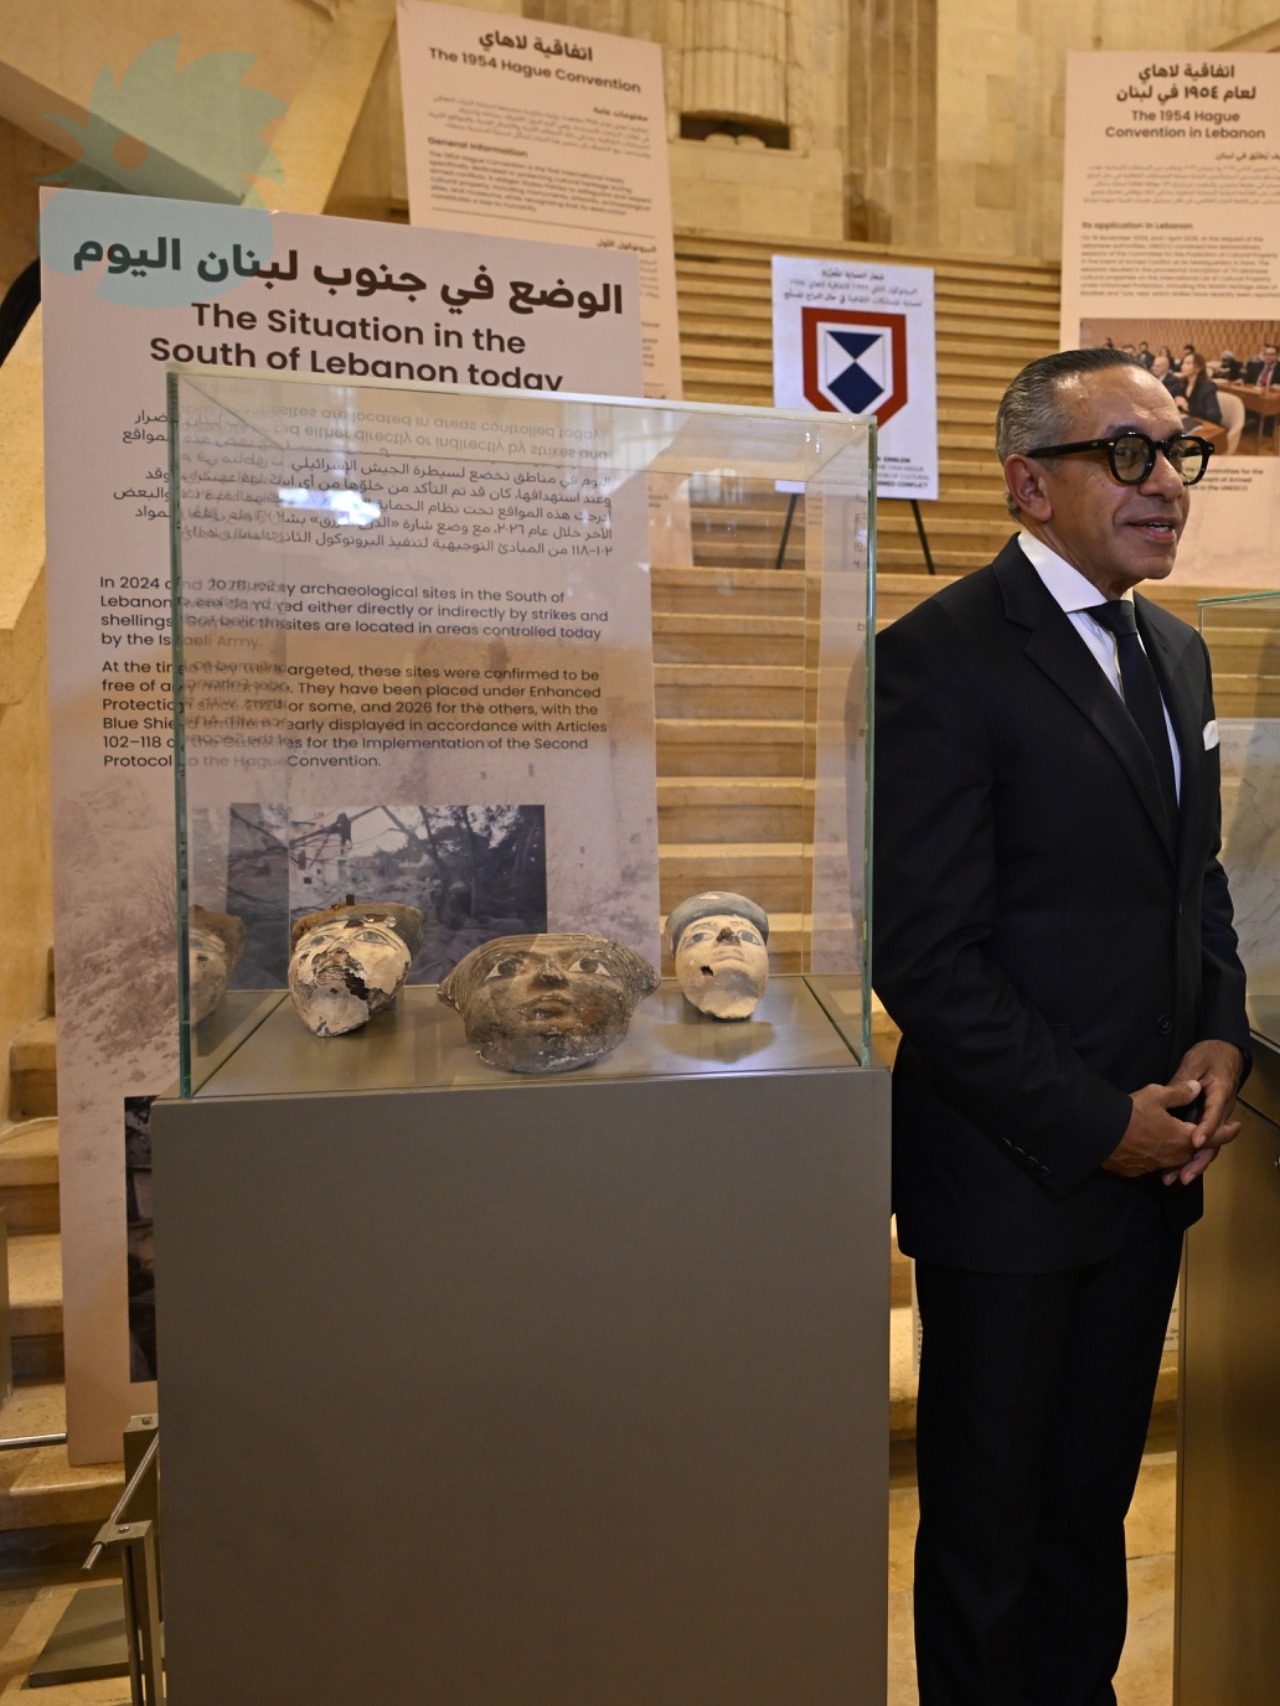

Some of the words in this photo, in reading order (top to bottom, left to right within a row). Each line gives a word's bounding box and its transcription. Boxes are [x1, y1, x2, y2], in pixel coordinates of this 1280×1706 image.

[479, 30, 527, 52] لاهاي
[533, 36, 593, 62] اتفاقية
[429, 46, 458, 63] The
[462, 51, 497, 69] 1954
[501, 59, 551, 79] Hague
[555, 68, 641, 93] Convention
[1138, 64, 1179, 84] لاهاي
[1184, 63, 1235, 80] اتفاقية
[1116, 85, 1152, 102] لبنان
[1157, 84, 1179, 104] في
[1184, 85, 1218, 100] ١٩٥٤
[1223, 86, 1256, 103] لعام
[1132, 110, 1156, 122] The
[1160, 109, 1191, 121] 1954
[1194, 111, 1240, 125] Hague
[1105, 126, 1186, 138] Convention
[1189, 126, 1202, 138] in
[1205, 127, 1265, 139] Lebanon
[74, 236, 180, 278] اليوم
[198, 243, 297, 290] لبنان
[314, 264, 426, 302] جنوب
[440, 264, 494, 315] في
[509, 278, 622, 317] الوضع
[191, 302, 257, 330] The
[268, 308, 423, 345] Situation
[434, 322, 463, 349] in
[473, 328, 525, 355] the
[151, 337, 255, 368] South
[267, 346, 300, 372] of
[311, 349, 458, 384] Lebanon
[468, 363, 562, 391] today
[100, 576, 114, 588] In
[120, 575, 160, 590] 2024
[300, 582, 418, 601] archaeological
[423, 586, 456, 600] sites
[461, 588, 473, 600] in
[478, 589, 501, 601] the
[506, 590, 547, 603] South
[551, 591, 564, 603] of
[101, 595, 171, 608] Lebanon
[307, 600, 353, 615] either
[357, 602, 414, 620] directly
[418, 606, 433, 616] or
[438, 604, 505, 622] indirectly
[510, 608, 527, 623] by
[532, 608, 576, 621] strikes
[580, 610, 608, 622] and
[102, 632, 122, 649] by
[127, 632, 154, 645] the
[286, 618, 320, 631] sites
[325, 622, 351, 632] are
[356, 619, 414, 634] located
[419, 621, 432, 634] in
[436, 625, 478, 636] areas
[483, 625, 556, 639] controlled
[560, 626, 601, 642] today
[358, 665, 401, 678] these
[406, 666, 440, 679] sites
[444, 668, 480, 679] were
[484, 666, 559, 682] confirmed
[563, 670, 577, 681] to
[581, 669, 599, 681] be
[102, 679, 135, 692] free
[140, 679, 155, 692] of
[299, 682, 335, 698] They
[340, 682, 378, 696] have
[383, 683, 422, 696] been
[425, 684, 478, 703] placed
[483, 685, 525, 697] under
[530, 685, 601, 698] Enhanced
[309, 702, 356, 714] some,
[361, 701, 394, 713] and
[396, 700, 432, 713] 2026
[436, 700, 456, 713] for
[461, 702, 485, 715] the
[489, 702, 537, 715] others,
[541, 703, 571, 715] with
[575, 703, 598, 715] the
[103, 717, 138, 729] Blue
[328, 717, 405, 734] displayed
[410, 719, 422, 731] in
[427, 720, 518, 732] accordance
[522, 719, 551, 732] with
[556, 720, 607, 732] Articles
[307, 736, 328, 749] for
[333, 737, 358, 750] the
[363, 737, 484, 752] Implementation
[487, 737, 502, 750] of
[507, 737, 530, 750] the
[534, 737, 588, 749] Second
[104, 754, 172, 767] Protocol
[288, 754, 381, 768] Convention.
